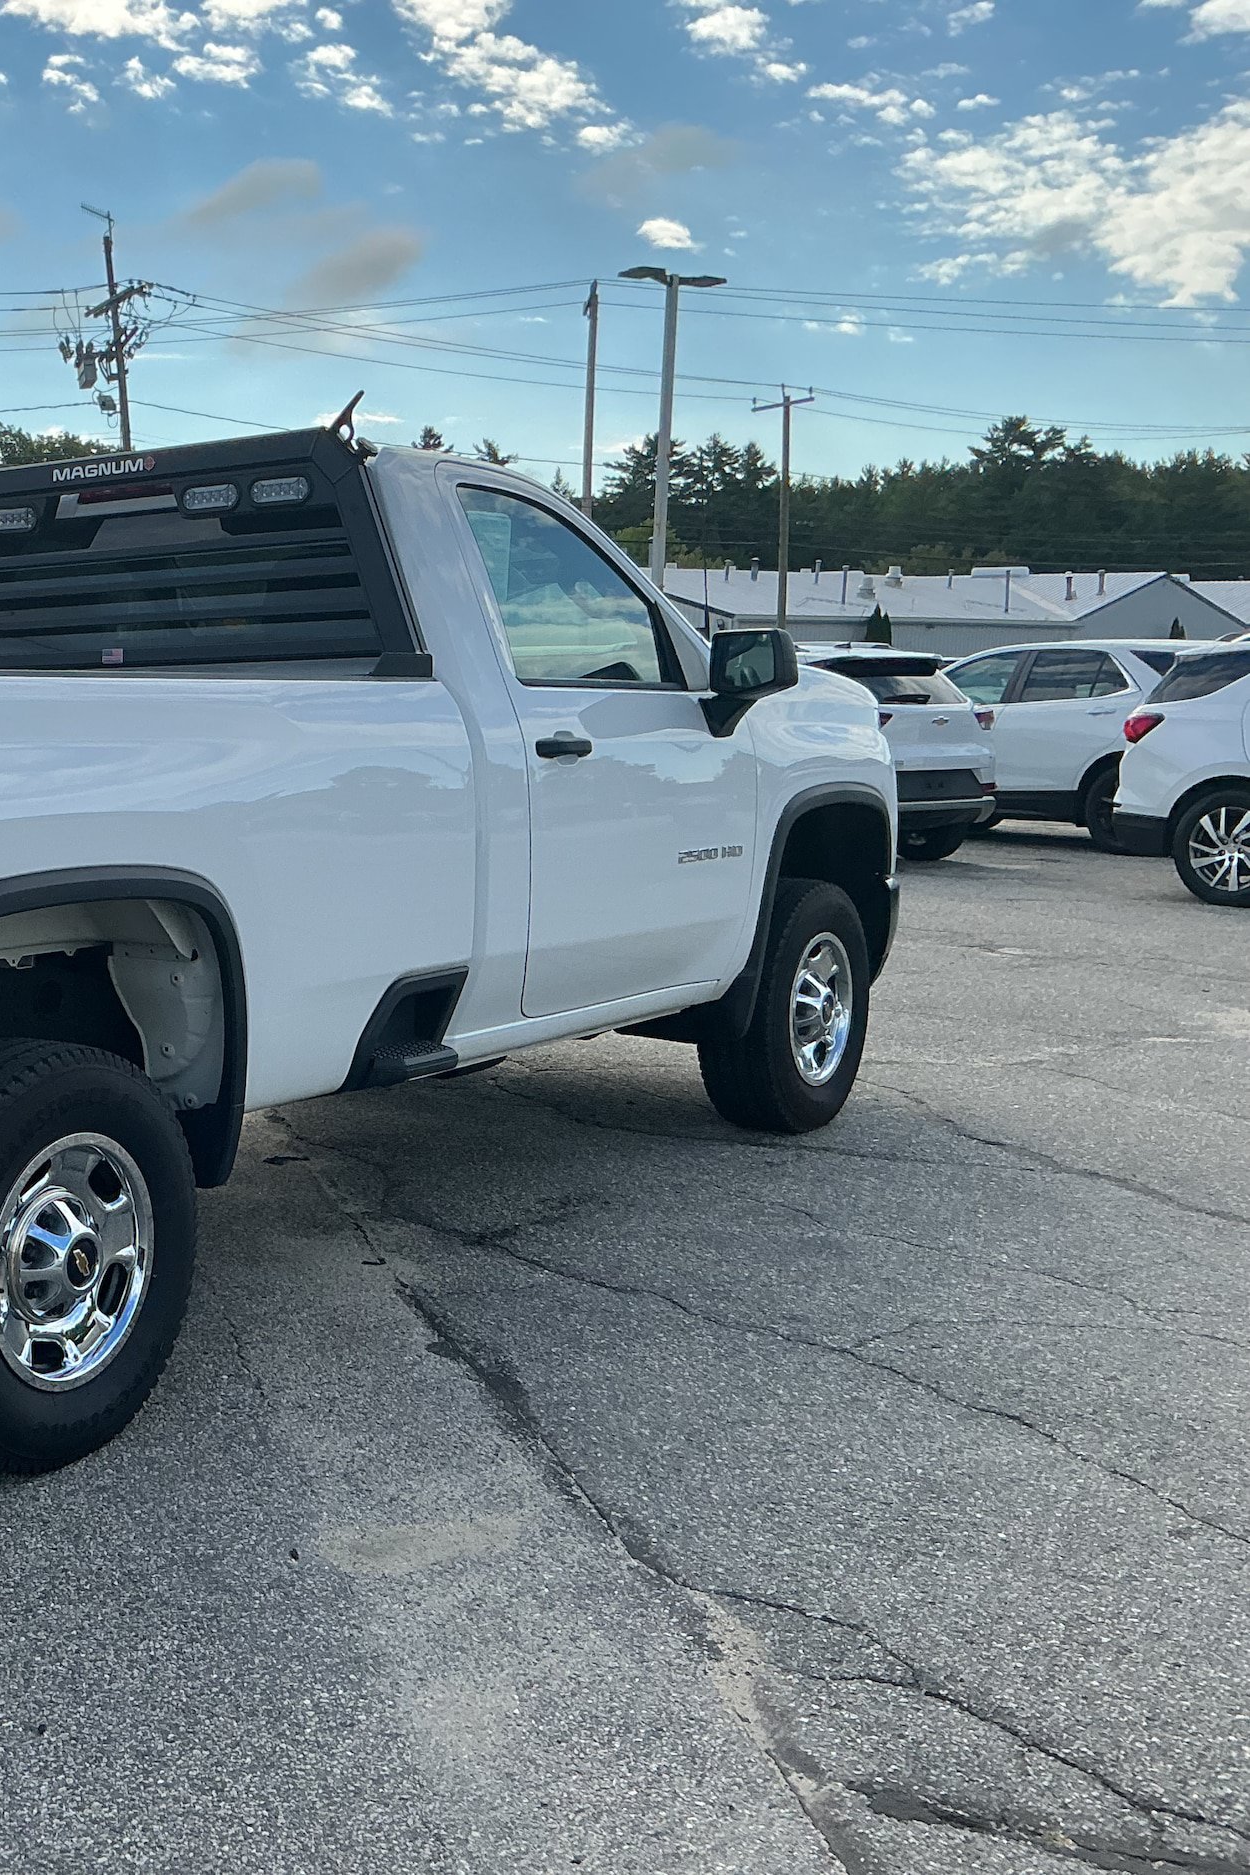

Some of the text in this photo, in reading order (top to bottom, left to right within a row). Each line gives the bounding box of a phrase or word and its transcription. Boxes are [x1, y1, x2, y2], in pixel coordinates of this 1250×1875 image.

[52, 458, 144, 482] MAGNUM
[677, 845, 743, 864] 2500 HD
